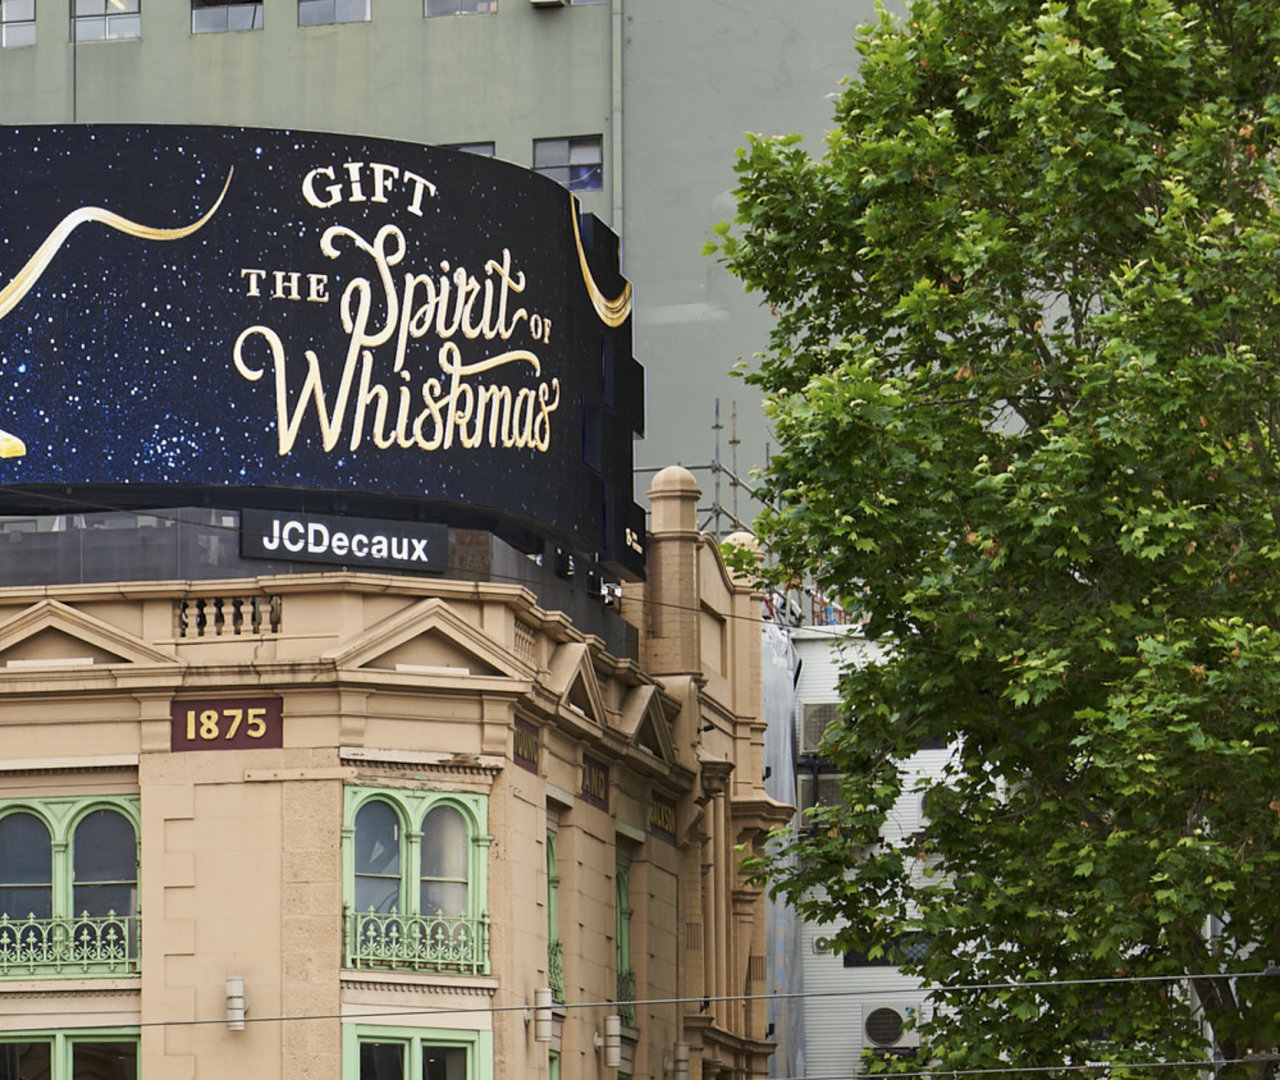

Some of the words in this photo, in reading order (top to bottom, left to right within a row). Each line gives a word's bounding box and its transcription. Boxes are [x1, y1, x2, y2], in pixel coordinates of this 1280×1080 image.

[302, 161, 438, 218] GIFT
[241, 268, 329, 302] THE
[320, 224, 528, 373] Spirit
[530, 313, 553, 344] OF
[233, 325, 560, 456] Whiskmas
[262, 519, 429, 563] JCDecaux
[187, 708, 268, 741] 1875
[584, 763, 605, 800] AND
